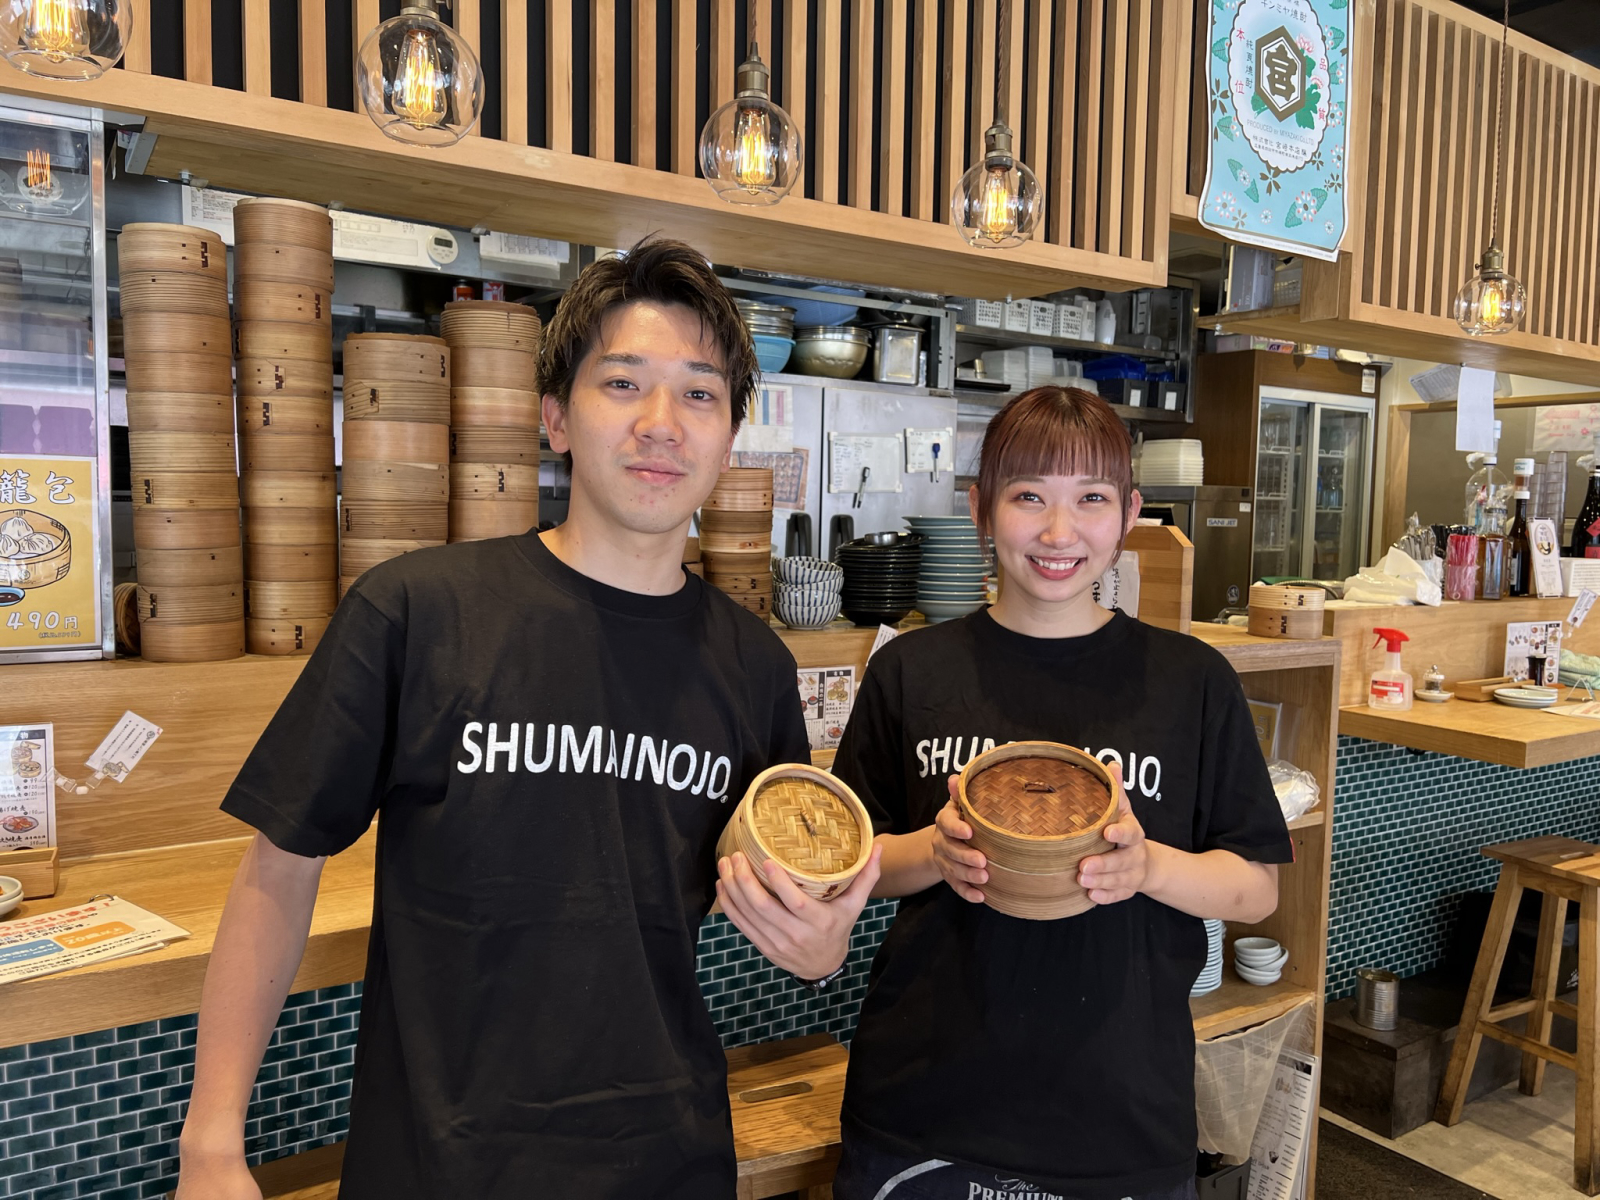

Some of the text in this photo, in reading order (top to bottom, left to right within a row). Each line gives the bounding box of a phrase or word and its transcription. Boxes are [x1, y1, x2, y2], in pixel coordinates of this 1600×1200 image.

[1246, 118, 1273, 134] PRODUCED
[1227, 519, 1237, 527] JET
[6, 611, 79, 631] 490円
[457, 721, 732, 800] SHUMAINOJO
[916, 736, 1161, 798] SHUOJO
[994, 1174, 1040, 1191] The
